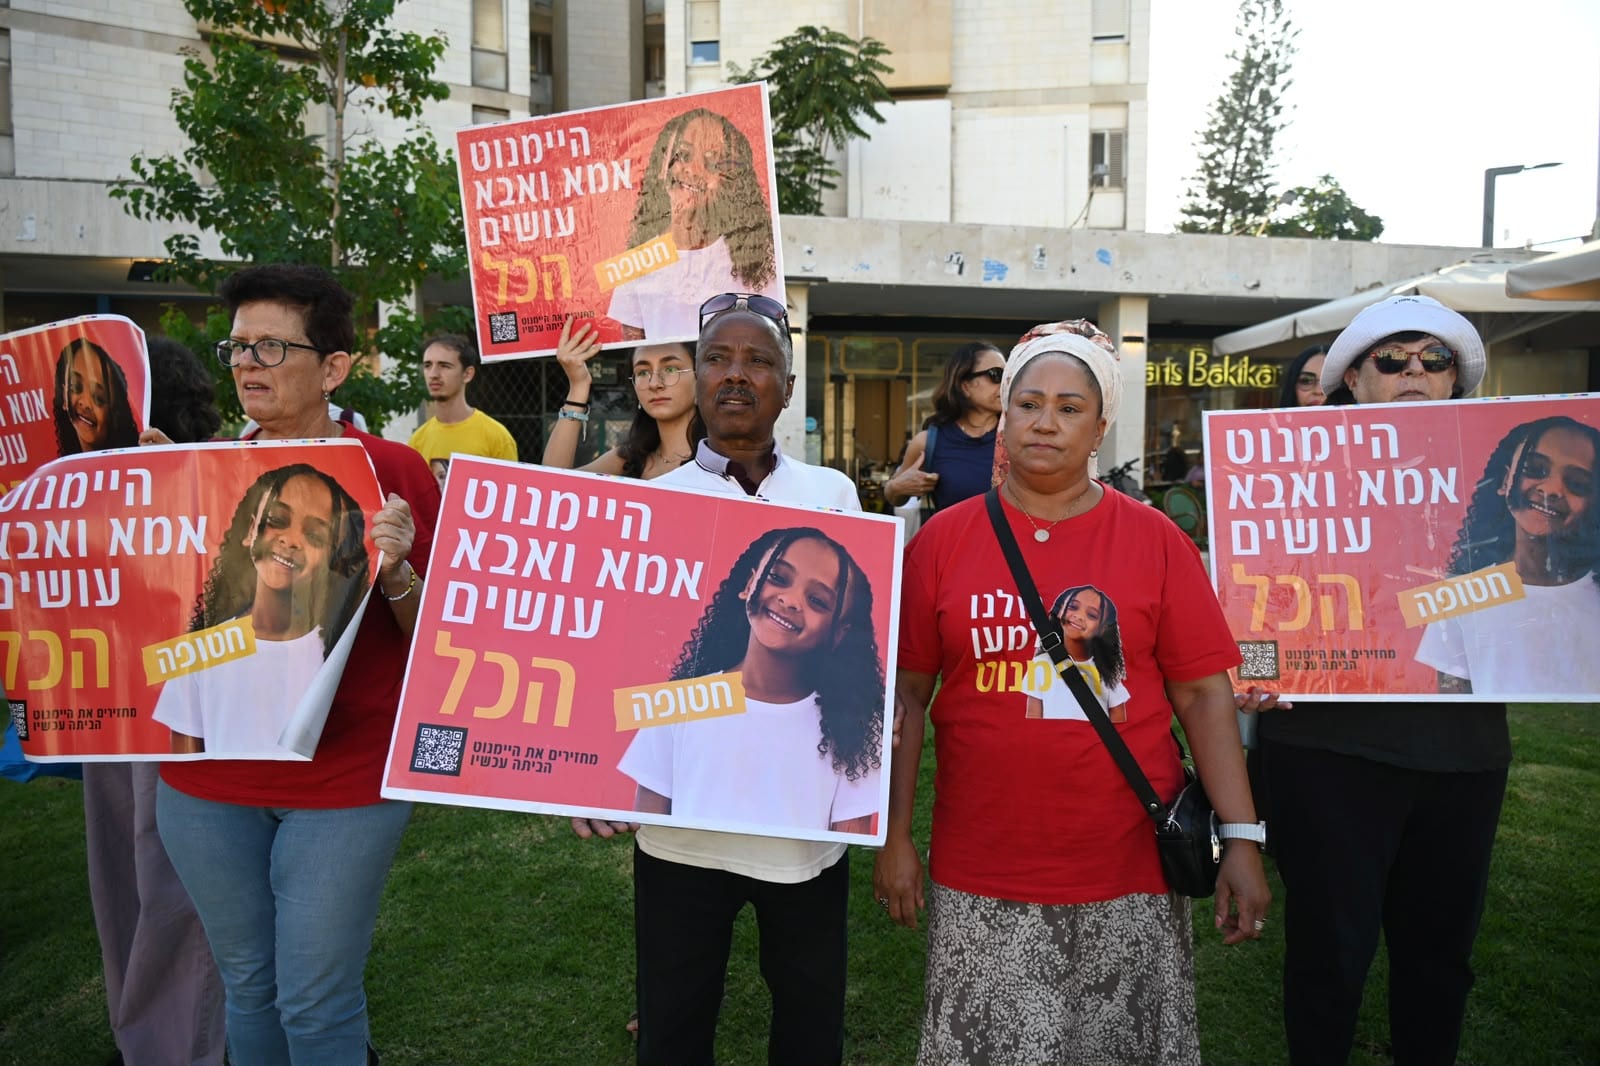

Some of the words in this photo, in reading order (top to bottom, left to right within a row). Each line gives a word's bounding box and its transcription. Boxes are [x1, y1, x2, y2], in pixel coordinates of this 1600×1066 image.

[470, 126, 590, 171] היימנוט
[473, 171, 548, 210] ואבא
[563, 159, 632, 197] אמא
[479, 207, 575, 246] עושים
[482, 252, 572, 306] הכל
[606, 240, 670, 283] חטופה
[6, 388, 50, 424] אמא
[1226, 423, 1399, 465] היימנוט
[1228, 472, 1336, 510] ואבא
[1359, 467, 1459, 506] אמא
[463, 478, 653, 543] היימנוט
[109, 515, 207, 556] אמא
[1231, 516, 1371, 556] עושים
[450, 528, 577, 584] ואבא
[596, 546, 705, 601] אמא
[441, 579, 604, 640] עושים
[1232, 563, 1363, 632] הכל
[1413, 573, 1512, 618] חטופה
[157, 623, 246, 675] חטופה
[1285, 649, 1327, 661] היימנוט
[1285, 660, 1319, 672] עכשיו
[1321, 660, 1357, 671] הביתה
[1331, 649, 1348, 660] את
[1351, 649, 1396, 660] מחזירים
[433, 630, 577, 728] הכל
[33, 707, 74, 720] היימנוט
[78, 707, 93, 719] את
[97, 706, 136, 718] מחזירים
[631, 680, 735, 722] חטופה
[33, 720, 66, 731] עכשיו
[68, 719, 101, 730] הביתה
[470, 755, 512, 770] עכשיו
[473, 741, 522, 757] היימנוט
[515, 757, 553, 774] הביתה
[527, 745, 545, 760] את
[547, 748, 598, 766] מחזירים
